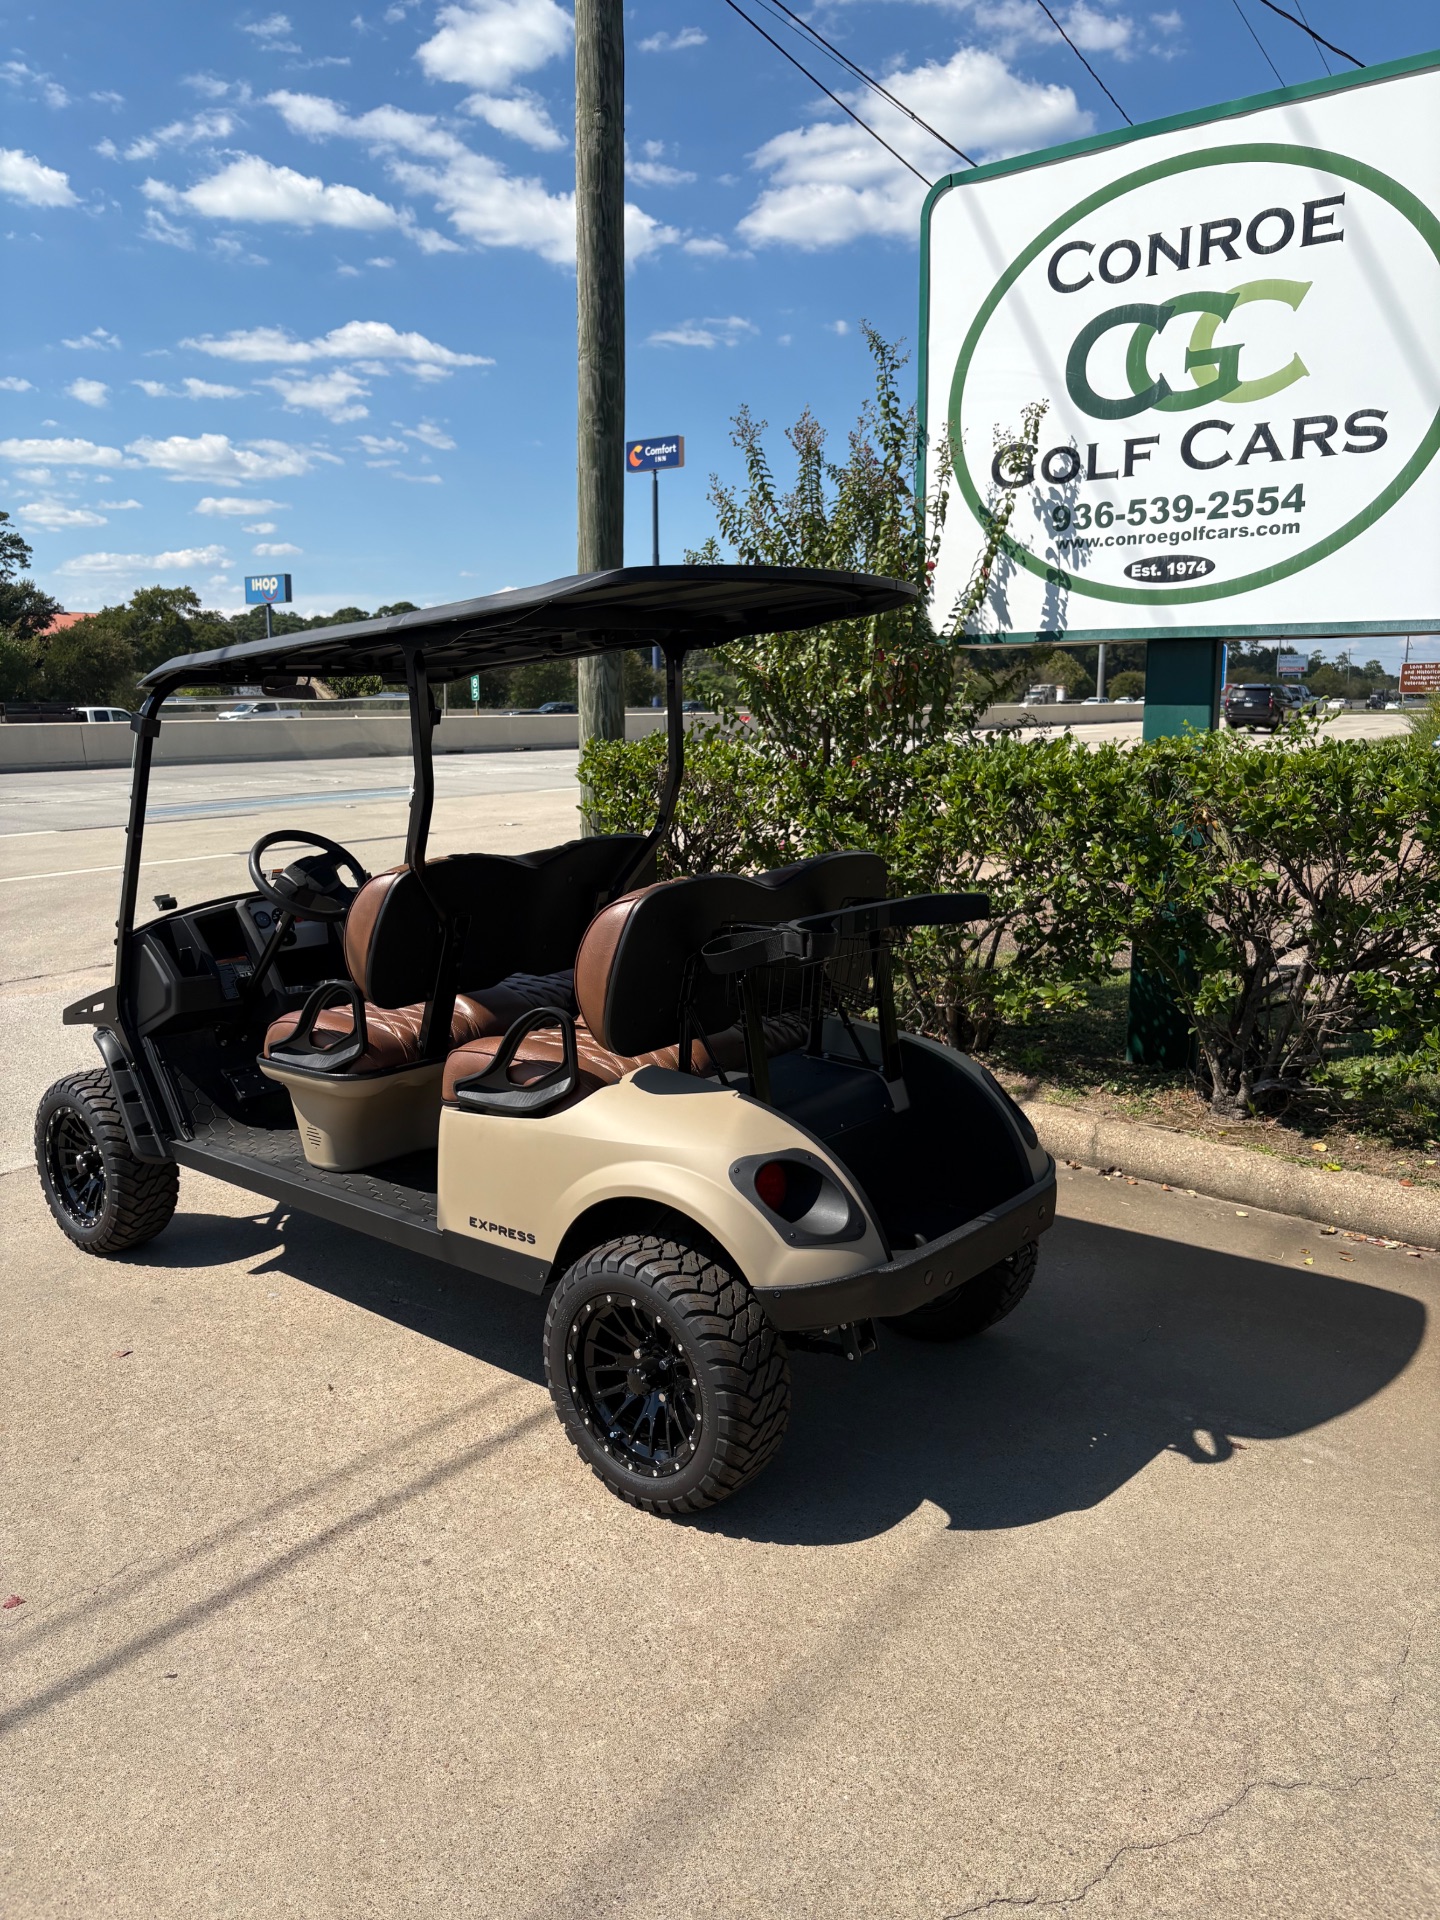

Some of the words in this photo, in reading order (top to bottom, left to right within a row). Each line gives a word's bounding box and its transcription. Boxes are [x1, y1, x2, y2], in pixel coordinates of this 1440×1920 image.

[1047, 192, 1346, 294] CONROE
[645, 443, 677, 456] Comfort
[654, 455, 667, 463] INN
[991, 433, 1161, 489] GOLF
[1180, 409, 1389, 471] CARS
[1052, 483, 1306, 532] 936-539-2554
[1056, 522, 1301, 550] www.conroegolfcars.com
[1131, 564, 1162, 578] Est.
[1166, 560, 1207, 575] 1974
[472, 677, 479, 699] 85
[469, 1216, 536, 1245] EXPRESS
